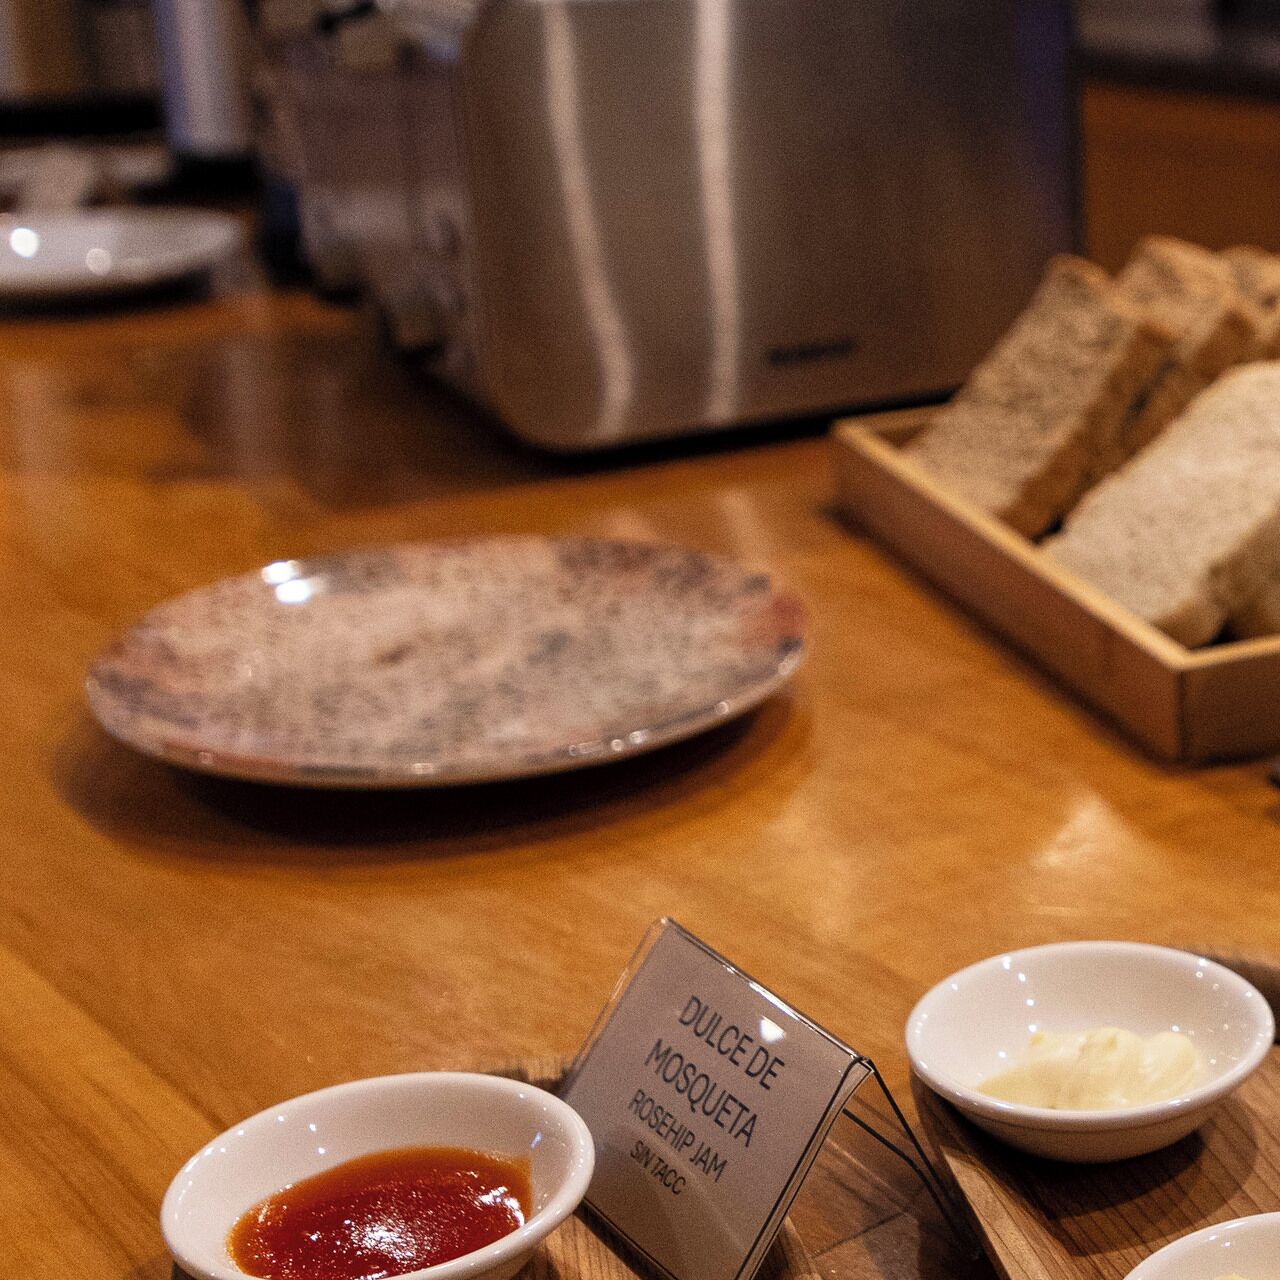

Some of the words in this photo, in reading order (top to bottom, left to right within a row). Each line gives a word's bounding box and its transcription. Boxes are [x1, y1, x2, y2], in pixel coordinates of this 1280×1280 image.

[679, 995, 753, 1066] DULCE
[746, 1047, 785, 1091] DE
[628, 1088, 696, 1153] ROSEHIP
[688, 1141, 728, 1183] JAM
[643, 1038, 759, 1148] MOSQUETA
[630, 1140, 656, 1169] SIN
[651, 1157, 686, 1195] TACC
